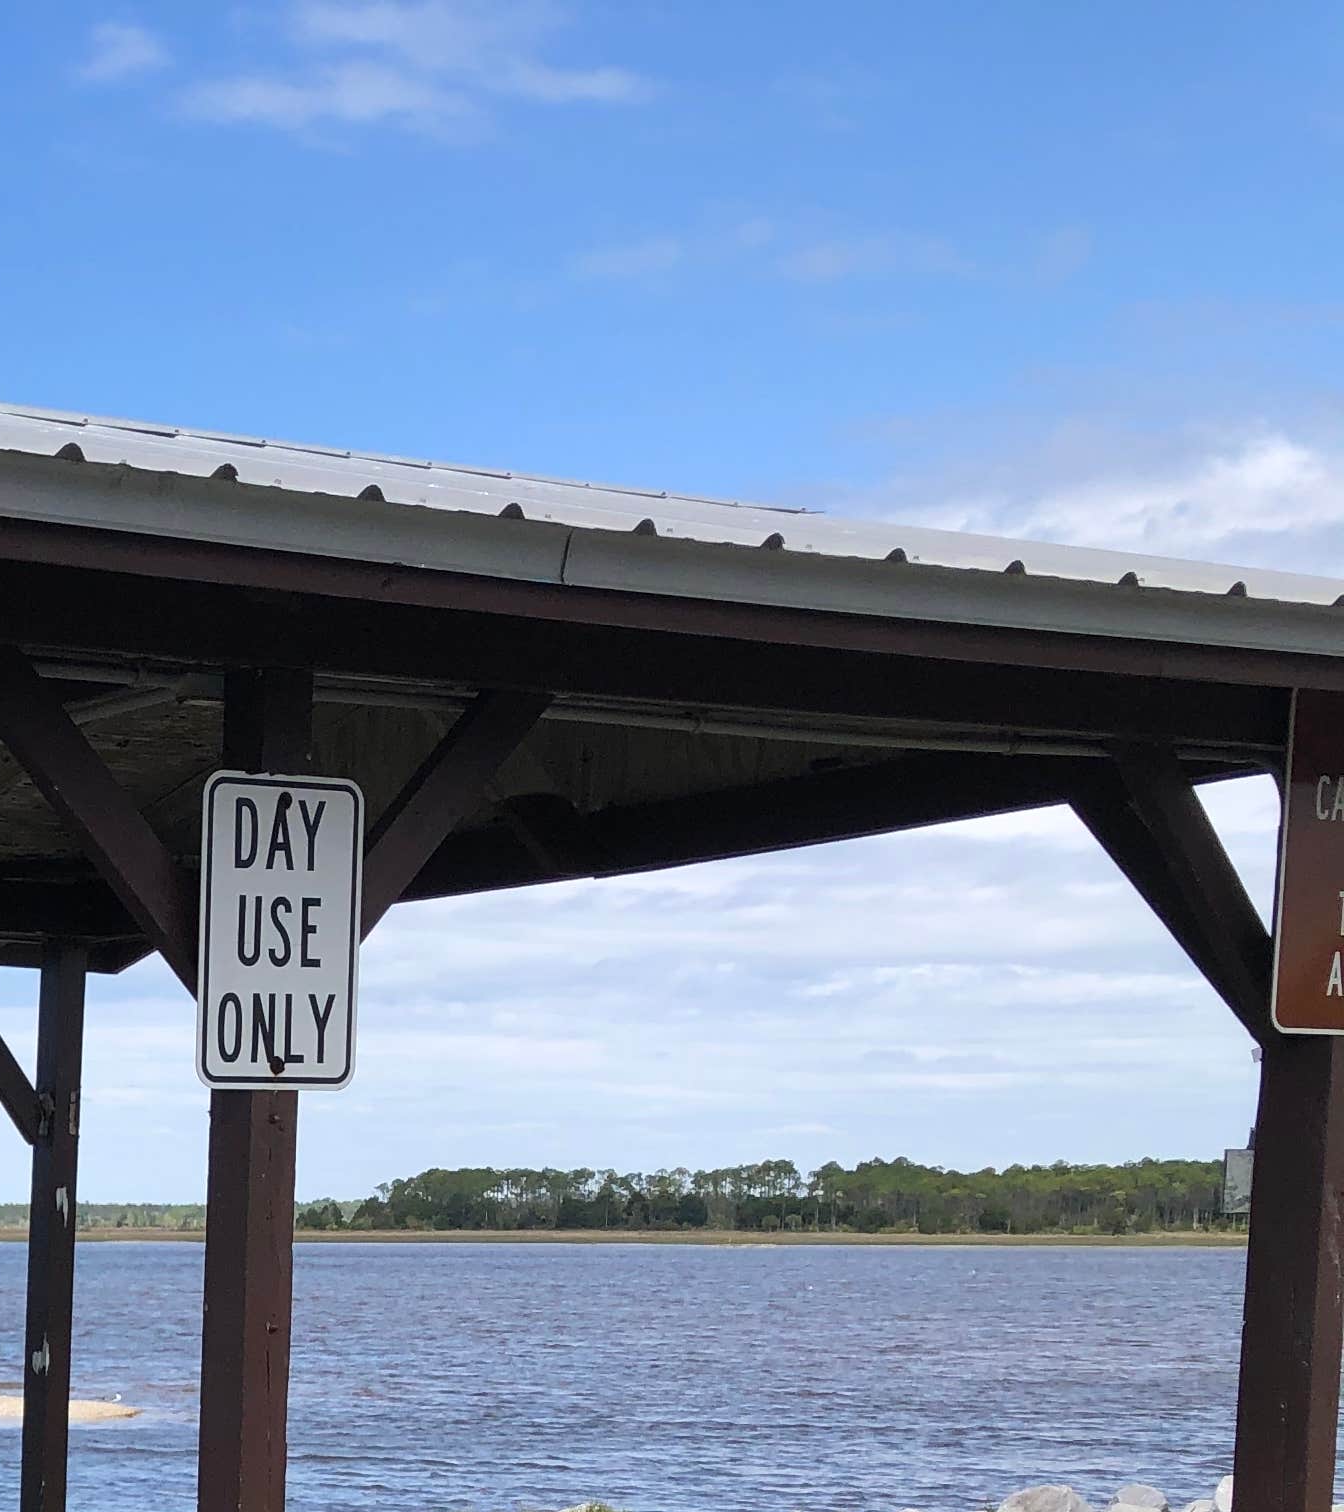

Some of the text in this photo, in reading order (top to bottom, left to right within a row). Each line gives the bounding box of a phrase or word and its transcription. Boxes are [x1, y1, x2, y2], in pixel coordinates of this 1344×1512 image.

[234, 796, 326, 871] DAY
[237, 895, 322, 968] USE
[217, 992, 336, 1064] ONLY
